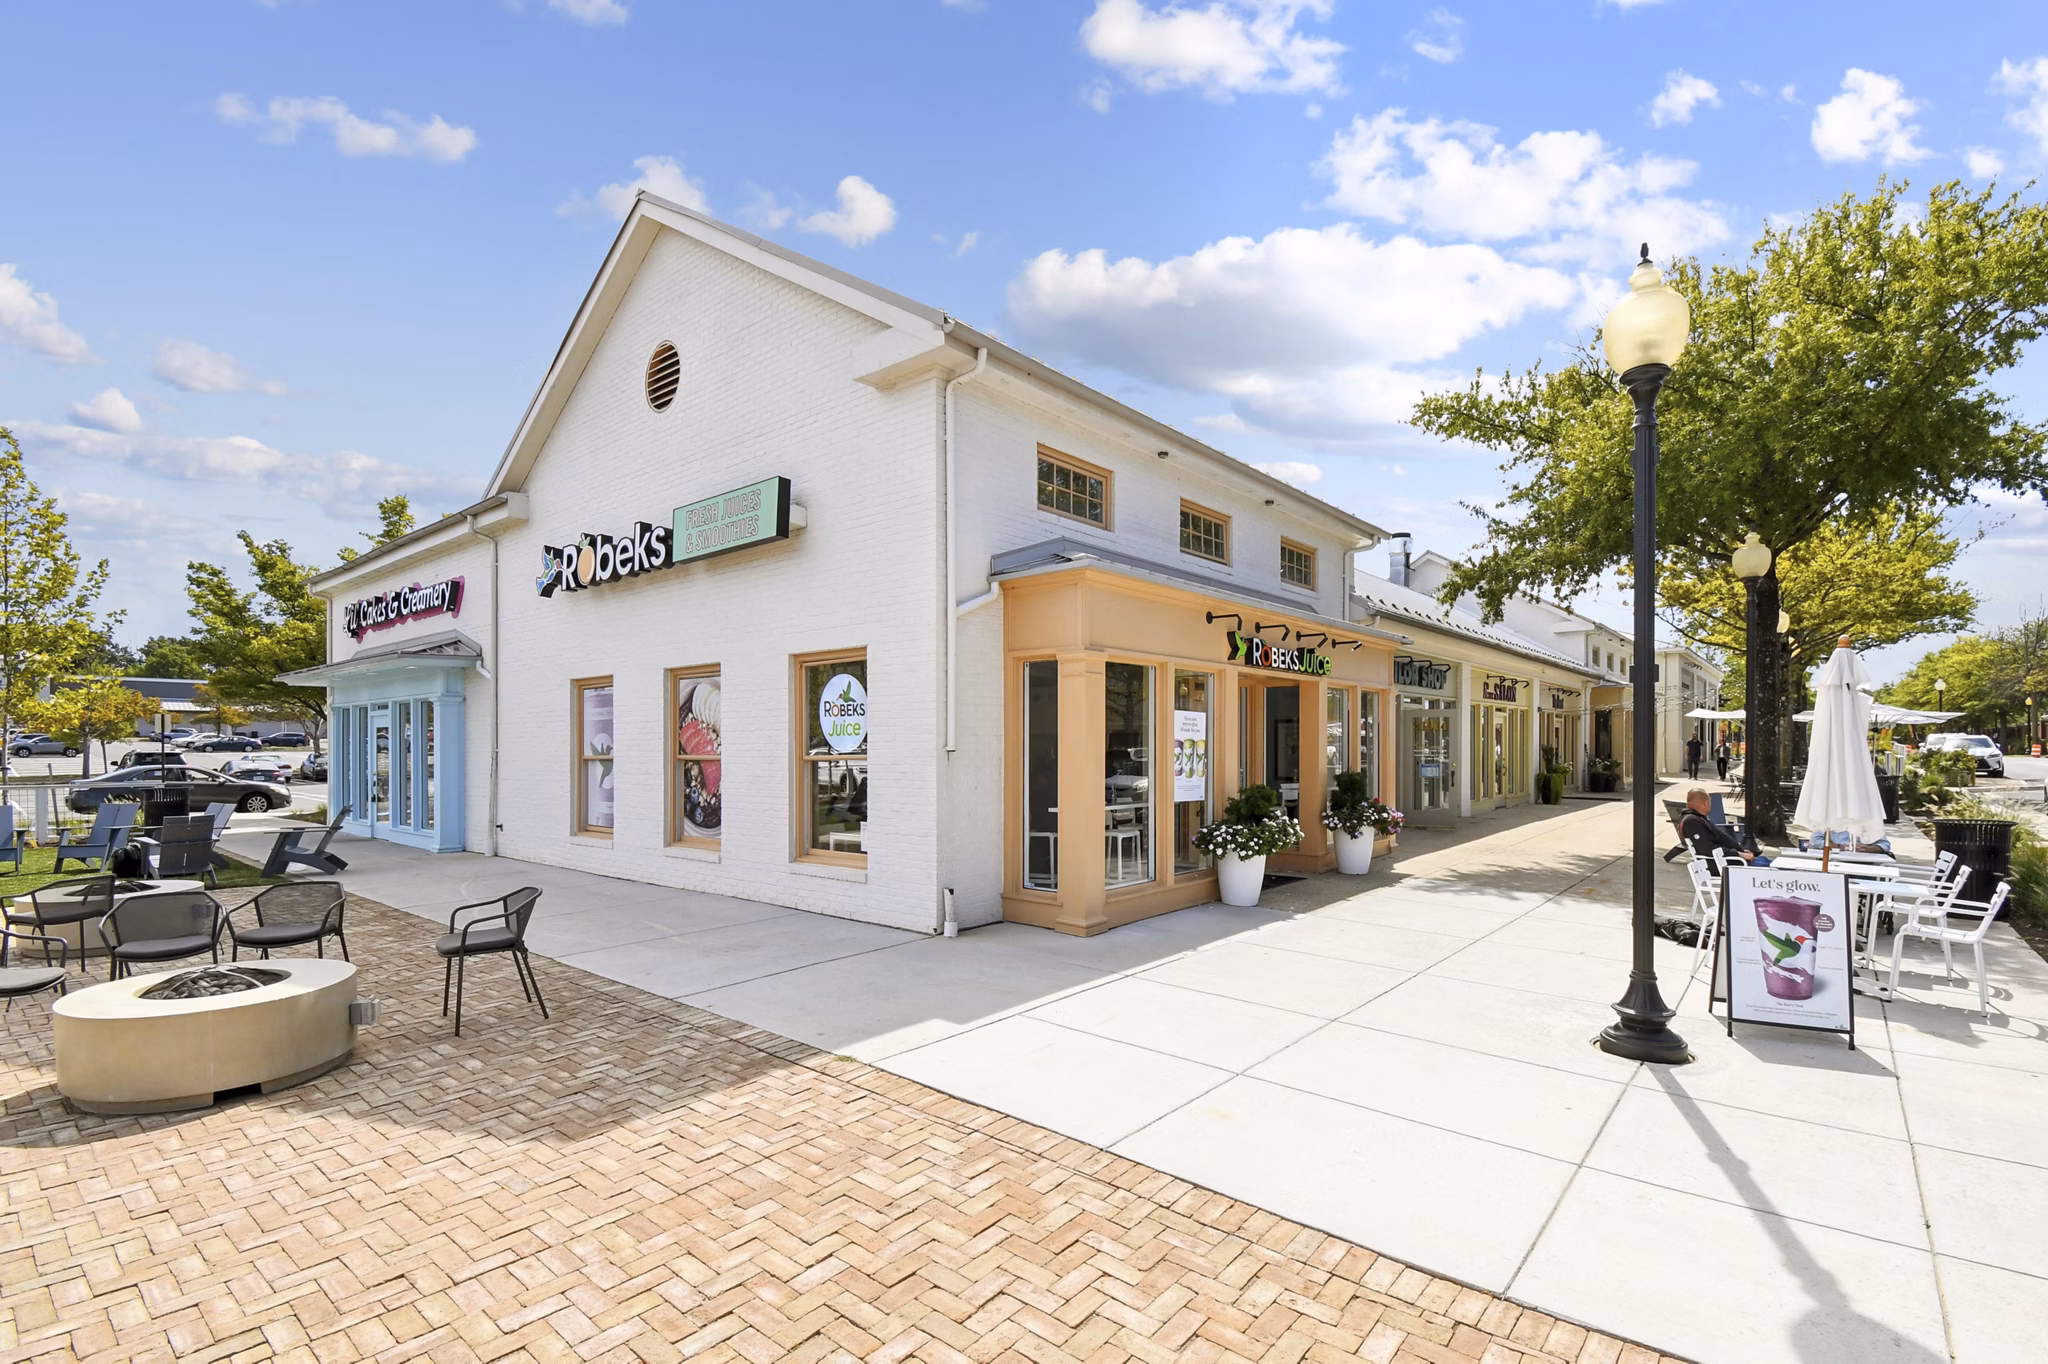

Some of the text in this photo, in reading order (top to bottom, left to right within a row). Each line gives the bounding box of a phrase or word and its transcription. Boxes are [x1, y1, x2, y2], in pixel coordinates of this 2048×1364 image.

[686, 489, 761, 530] FRESH JUICES
[686, 514, 759, 554] & SMOOTHIES
[361, 596, 386, 627] Cakes
[388, 592, 398, 618] &
[401, 580, 451, 615] Creamery
[1253, 637, 1332, 676] ROBEKS Juice
[1394, 660, 1448, 690] ILOR SHOP
[824, 701, 866, 717] ROBEKS
[828, 720, 861, 736] Juice
[1752, 877, 1821, 893] Let's glow.
